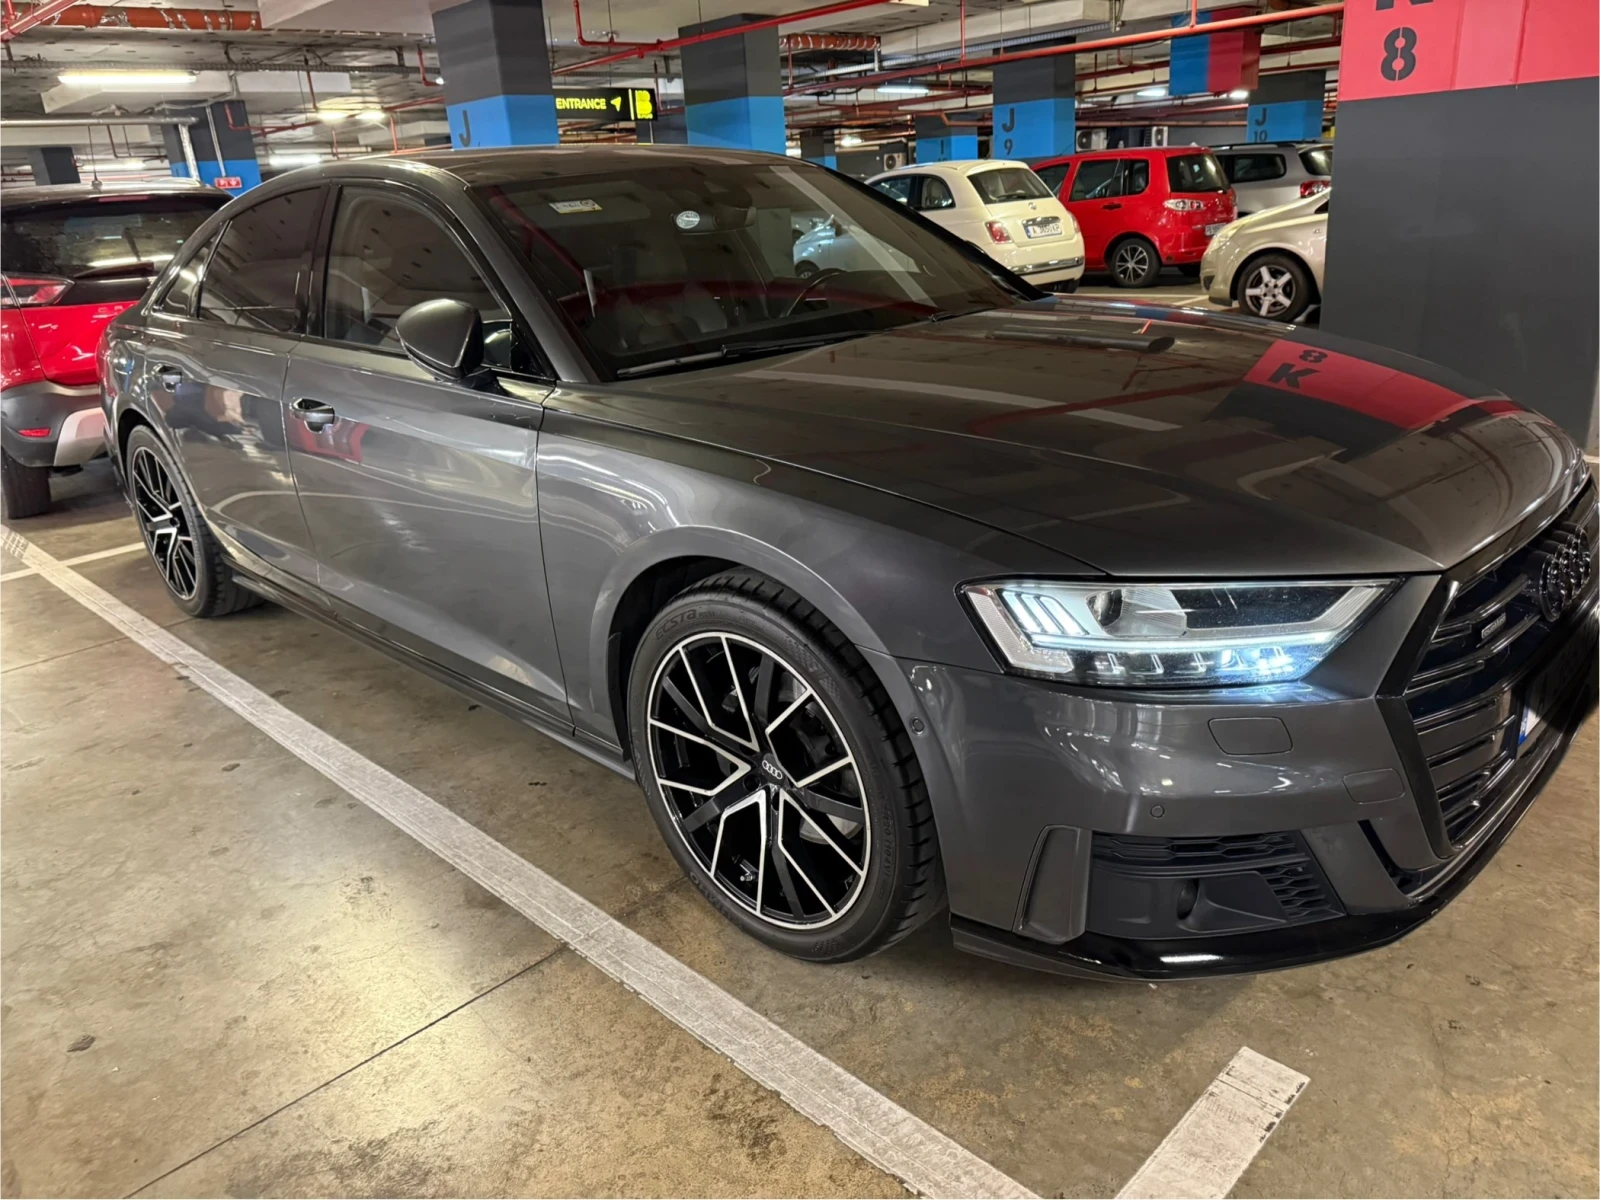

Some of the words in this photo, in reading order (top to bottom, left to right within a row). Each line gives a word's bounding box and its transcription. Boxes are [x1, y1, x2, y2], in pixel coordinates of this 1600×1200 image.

[1381, 27, 1417, 81] 8
[556, 98, 607, 109] ENTRANCE
[1002, 108, 1015, 132] J
[1255, 107, 1267, 126] J
[458, 110, 471, 147] J
[1254, 130, 1267, 143] 10
[1004, 139, 1013, 155] 9
